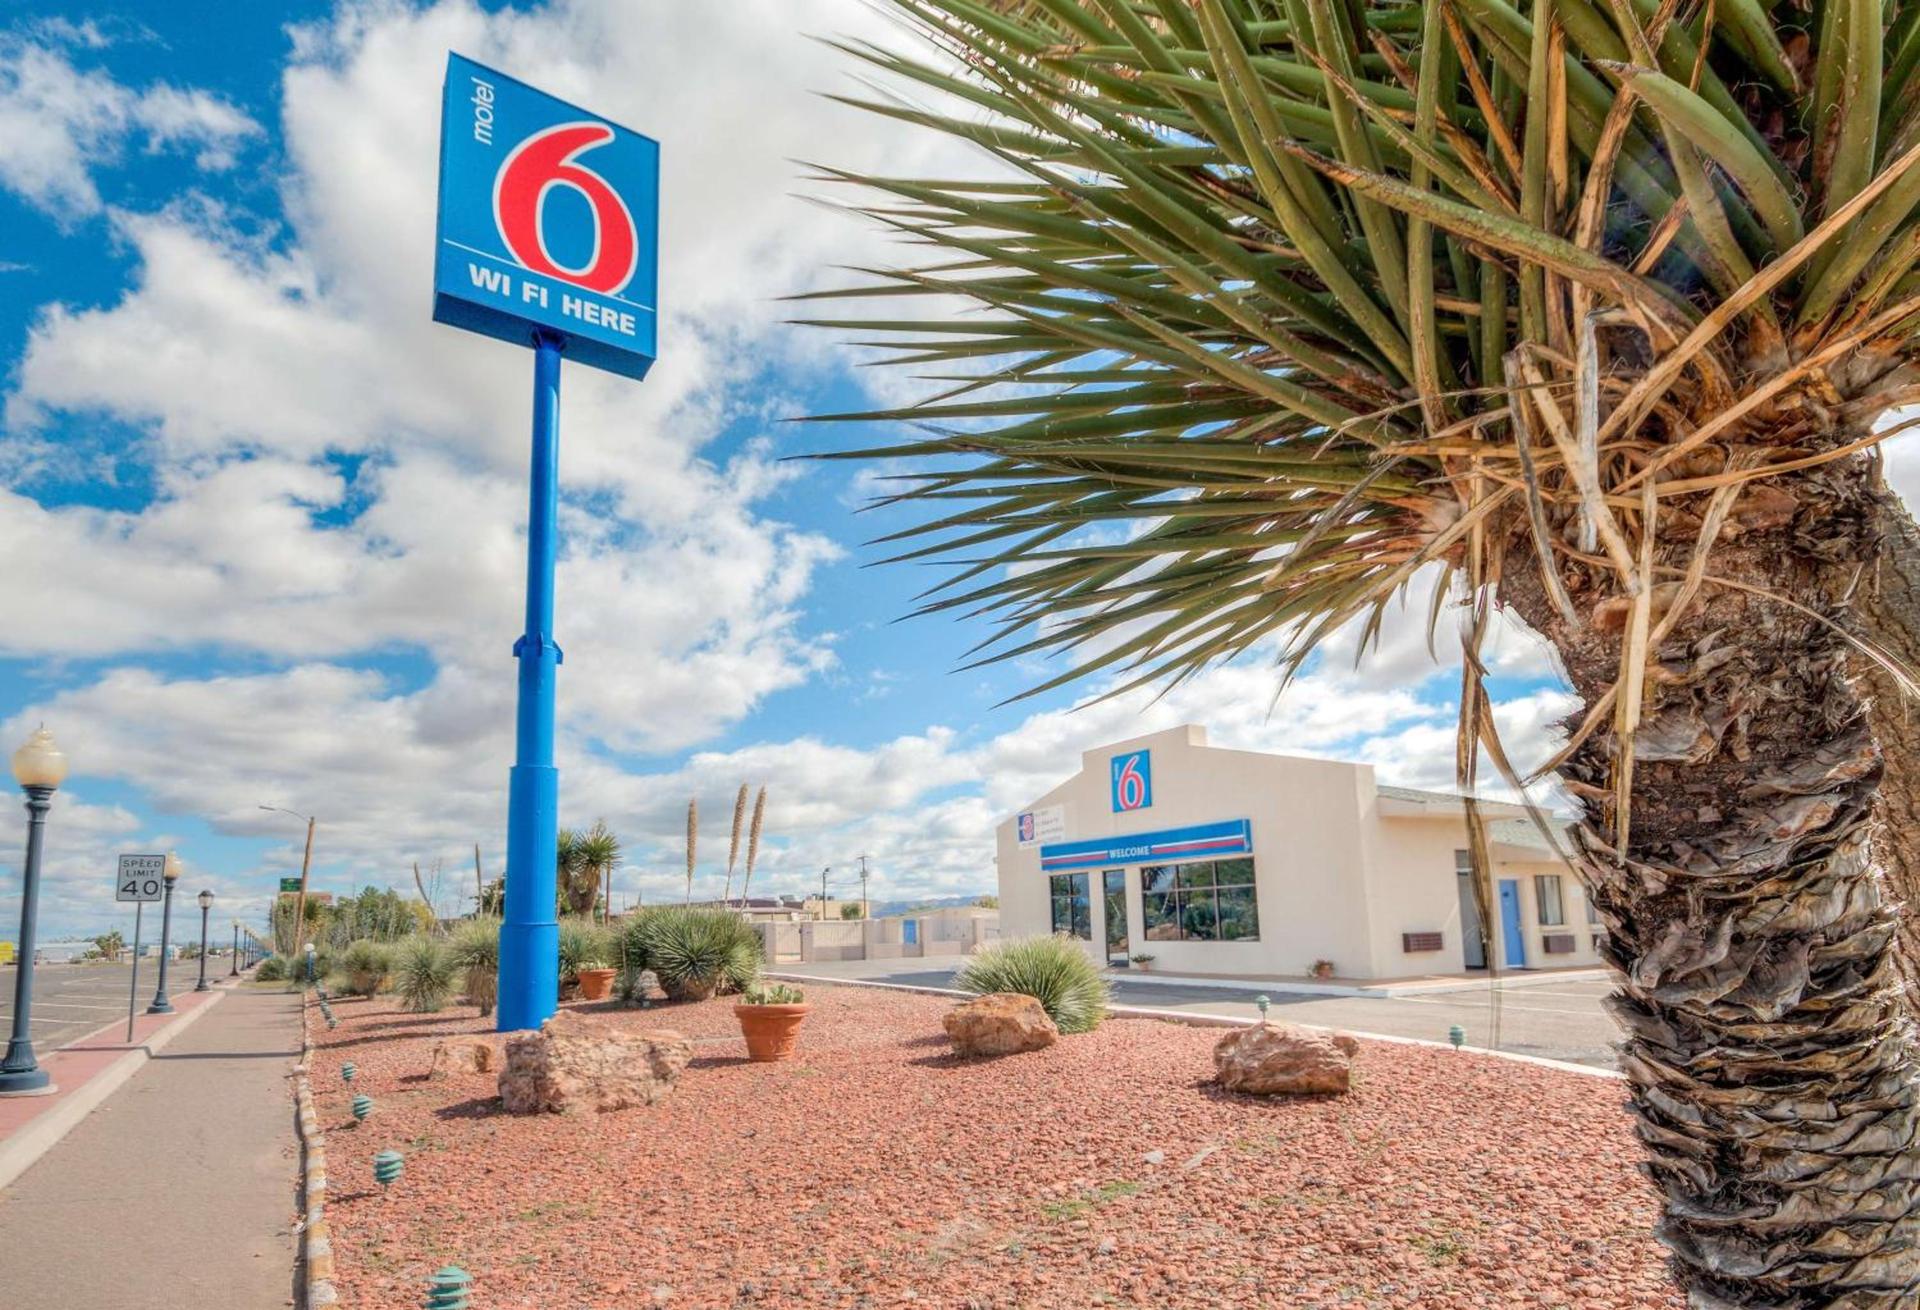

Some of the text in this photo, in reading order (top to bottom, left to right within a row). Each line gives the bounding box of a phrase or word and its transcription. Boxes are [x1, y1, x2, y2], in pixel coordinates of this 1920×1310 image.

[471, 77, 494, 146] motel
[492, 121, 638, 296] 6
[468, 263, 636, 337] WI FI HERE
[1118, 755, 1145, 810] 6
[123, 859, 161, 867] SPEED
[1109, 846, 1150, 858] WELCOME
[121, 880, 159, 895] 40
